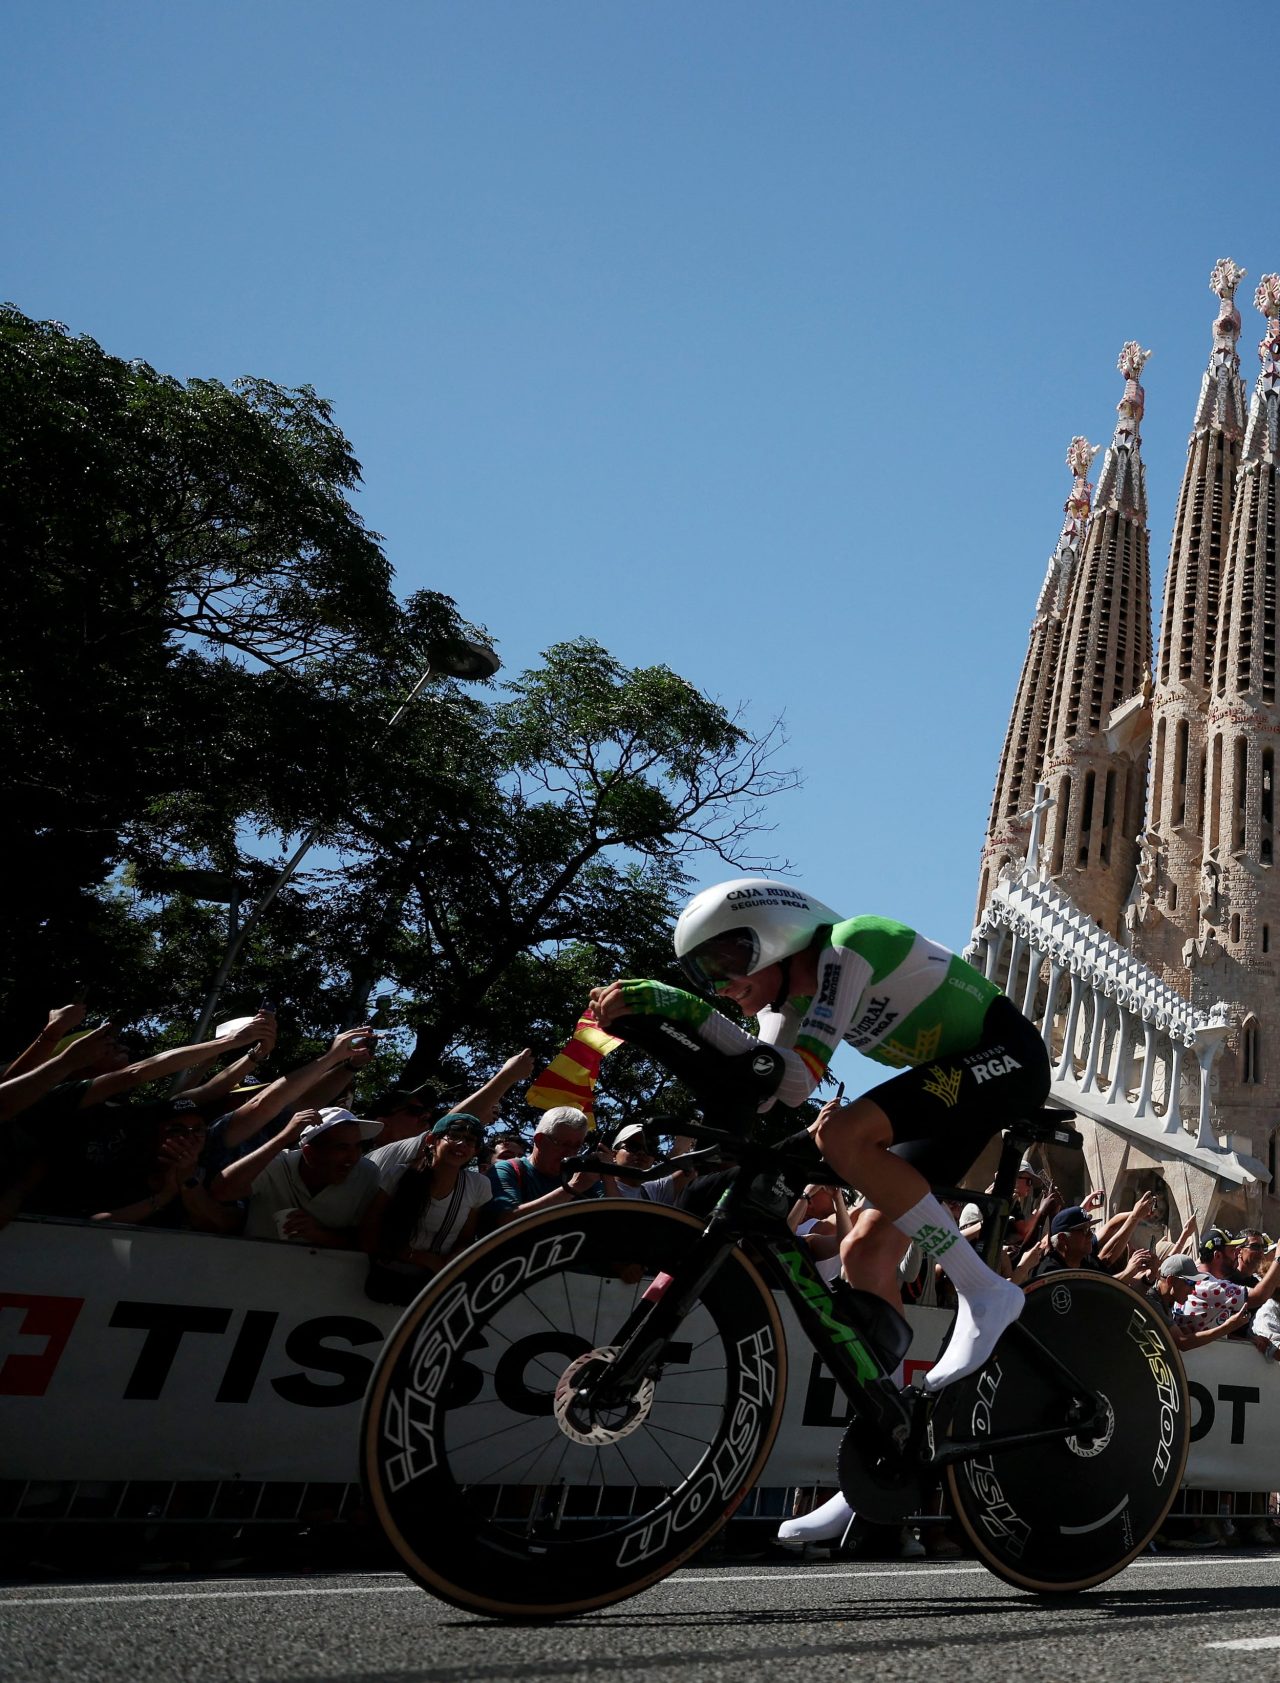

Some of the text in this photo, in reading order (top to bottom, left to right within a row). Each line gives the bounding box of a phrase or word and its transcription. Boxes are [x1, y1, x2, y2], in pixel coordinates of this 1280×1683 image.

[726, 887, 807, 901] CAJA RURAL
[731, 899, 810, 912] SEGUROS RGA
[963, 1045, 1006, 1065] SEGUROS
[970, 1054, 1024, 1085] RGA
